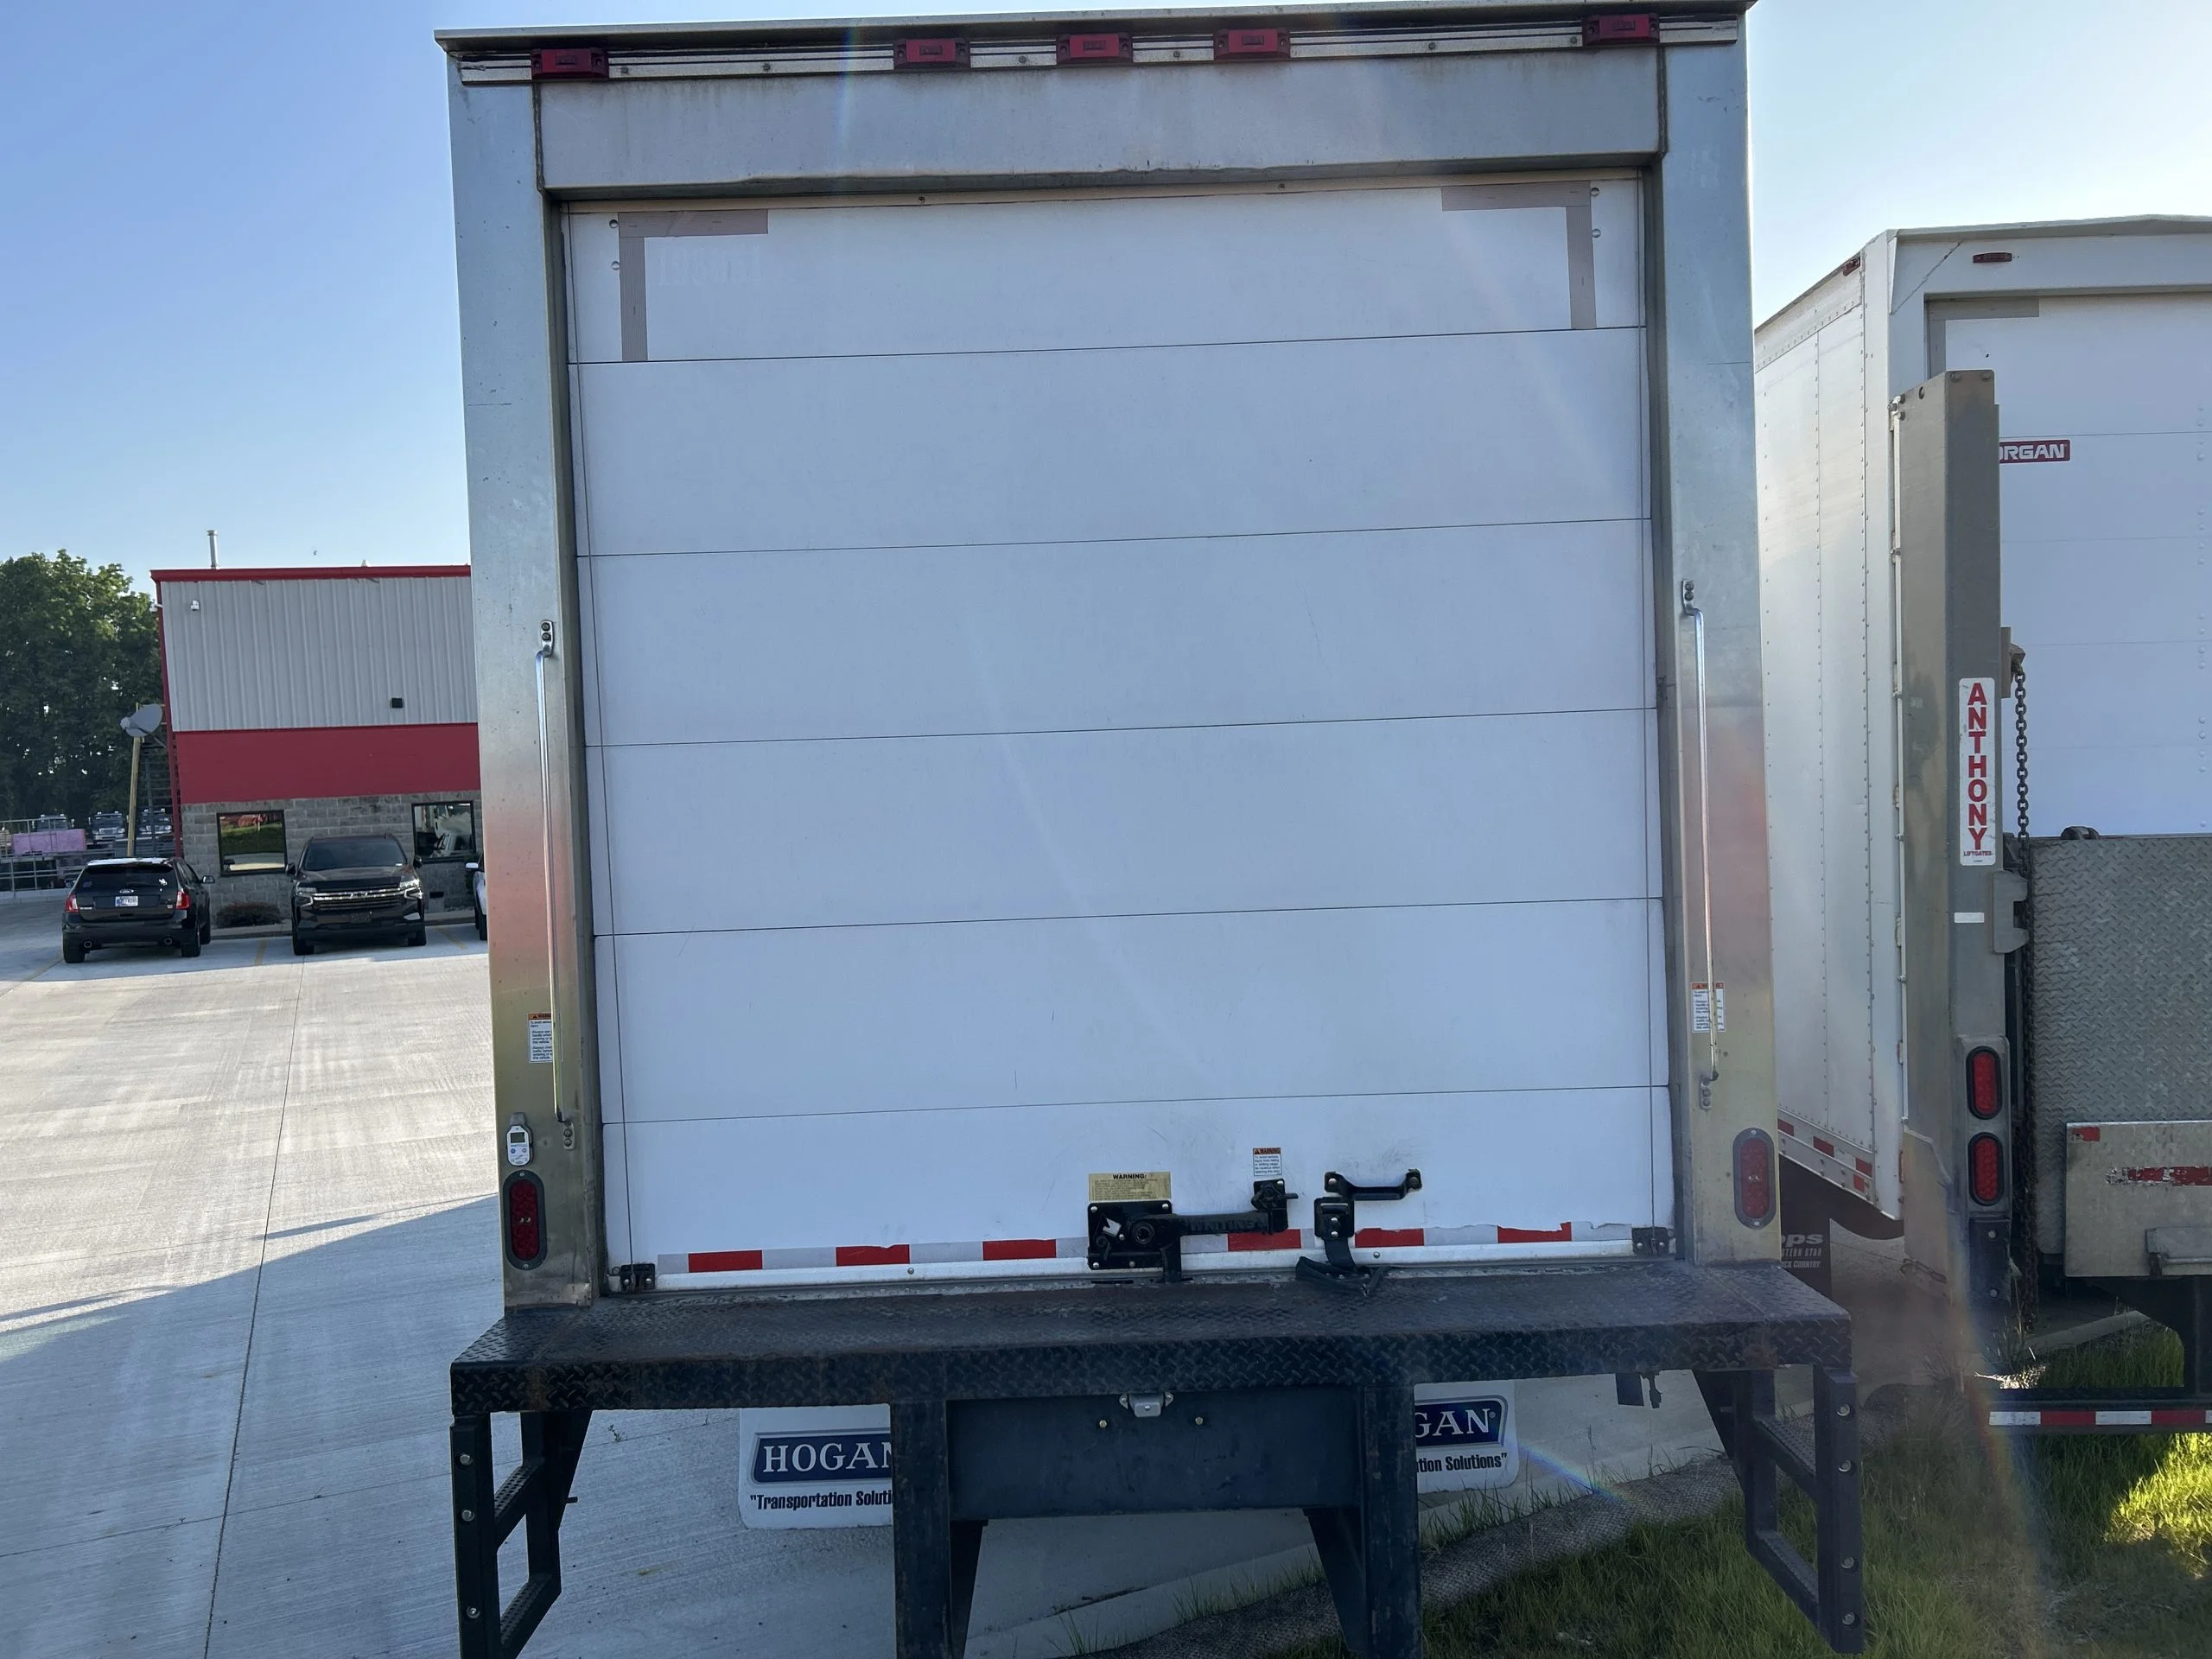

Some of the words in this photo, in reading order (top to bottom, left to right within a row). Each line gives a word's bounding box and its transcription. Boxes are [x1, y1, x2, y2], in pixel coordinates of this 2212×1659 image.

[1967, 683, 1987, 850] ANTHONY
[1417, 1457, 1443, 1473] tion
[750, 1491, 852, 1510] "Transportation
[855, 1489, 892, 1506] Soluti
